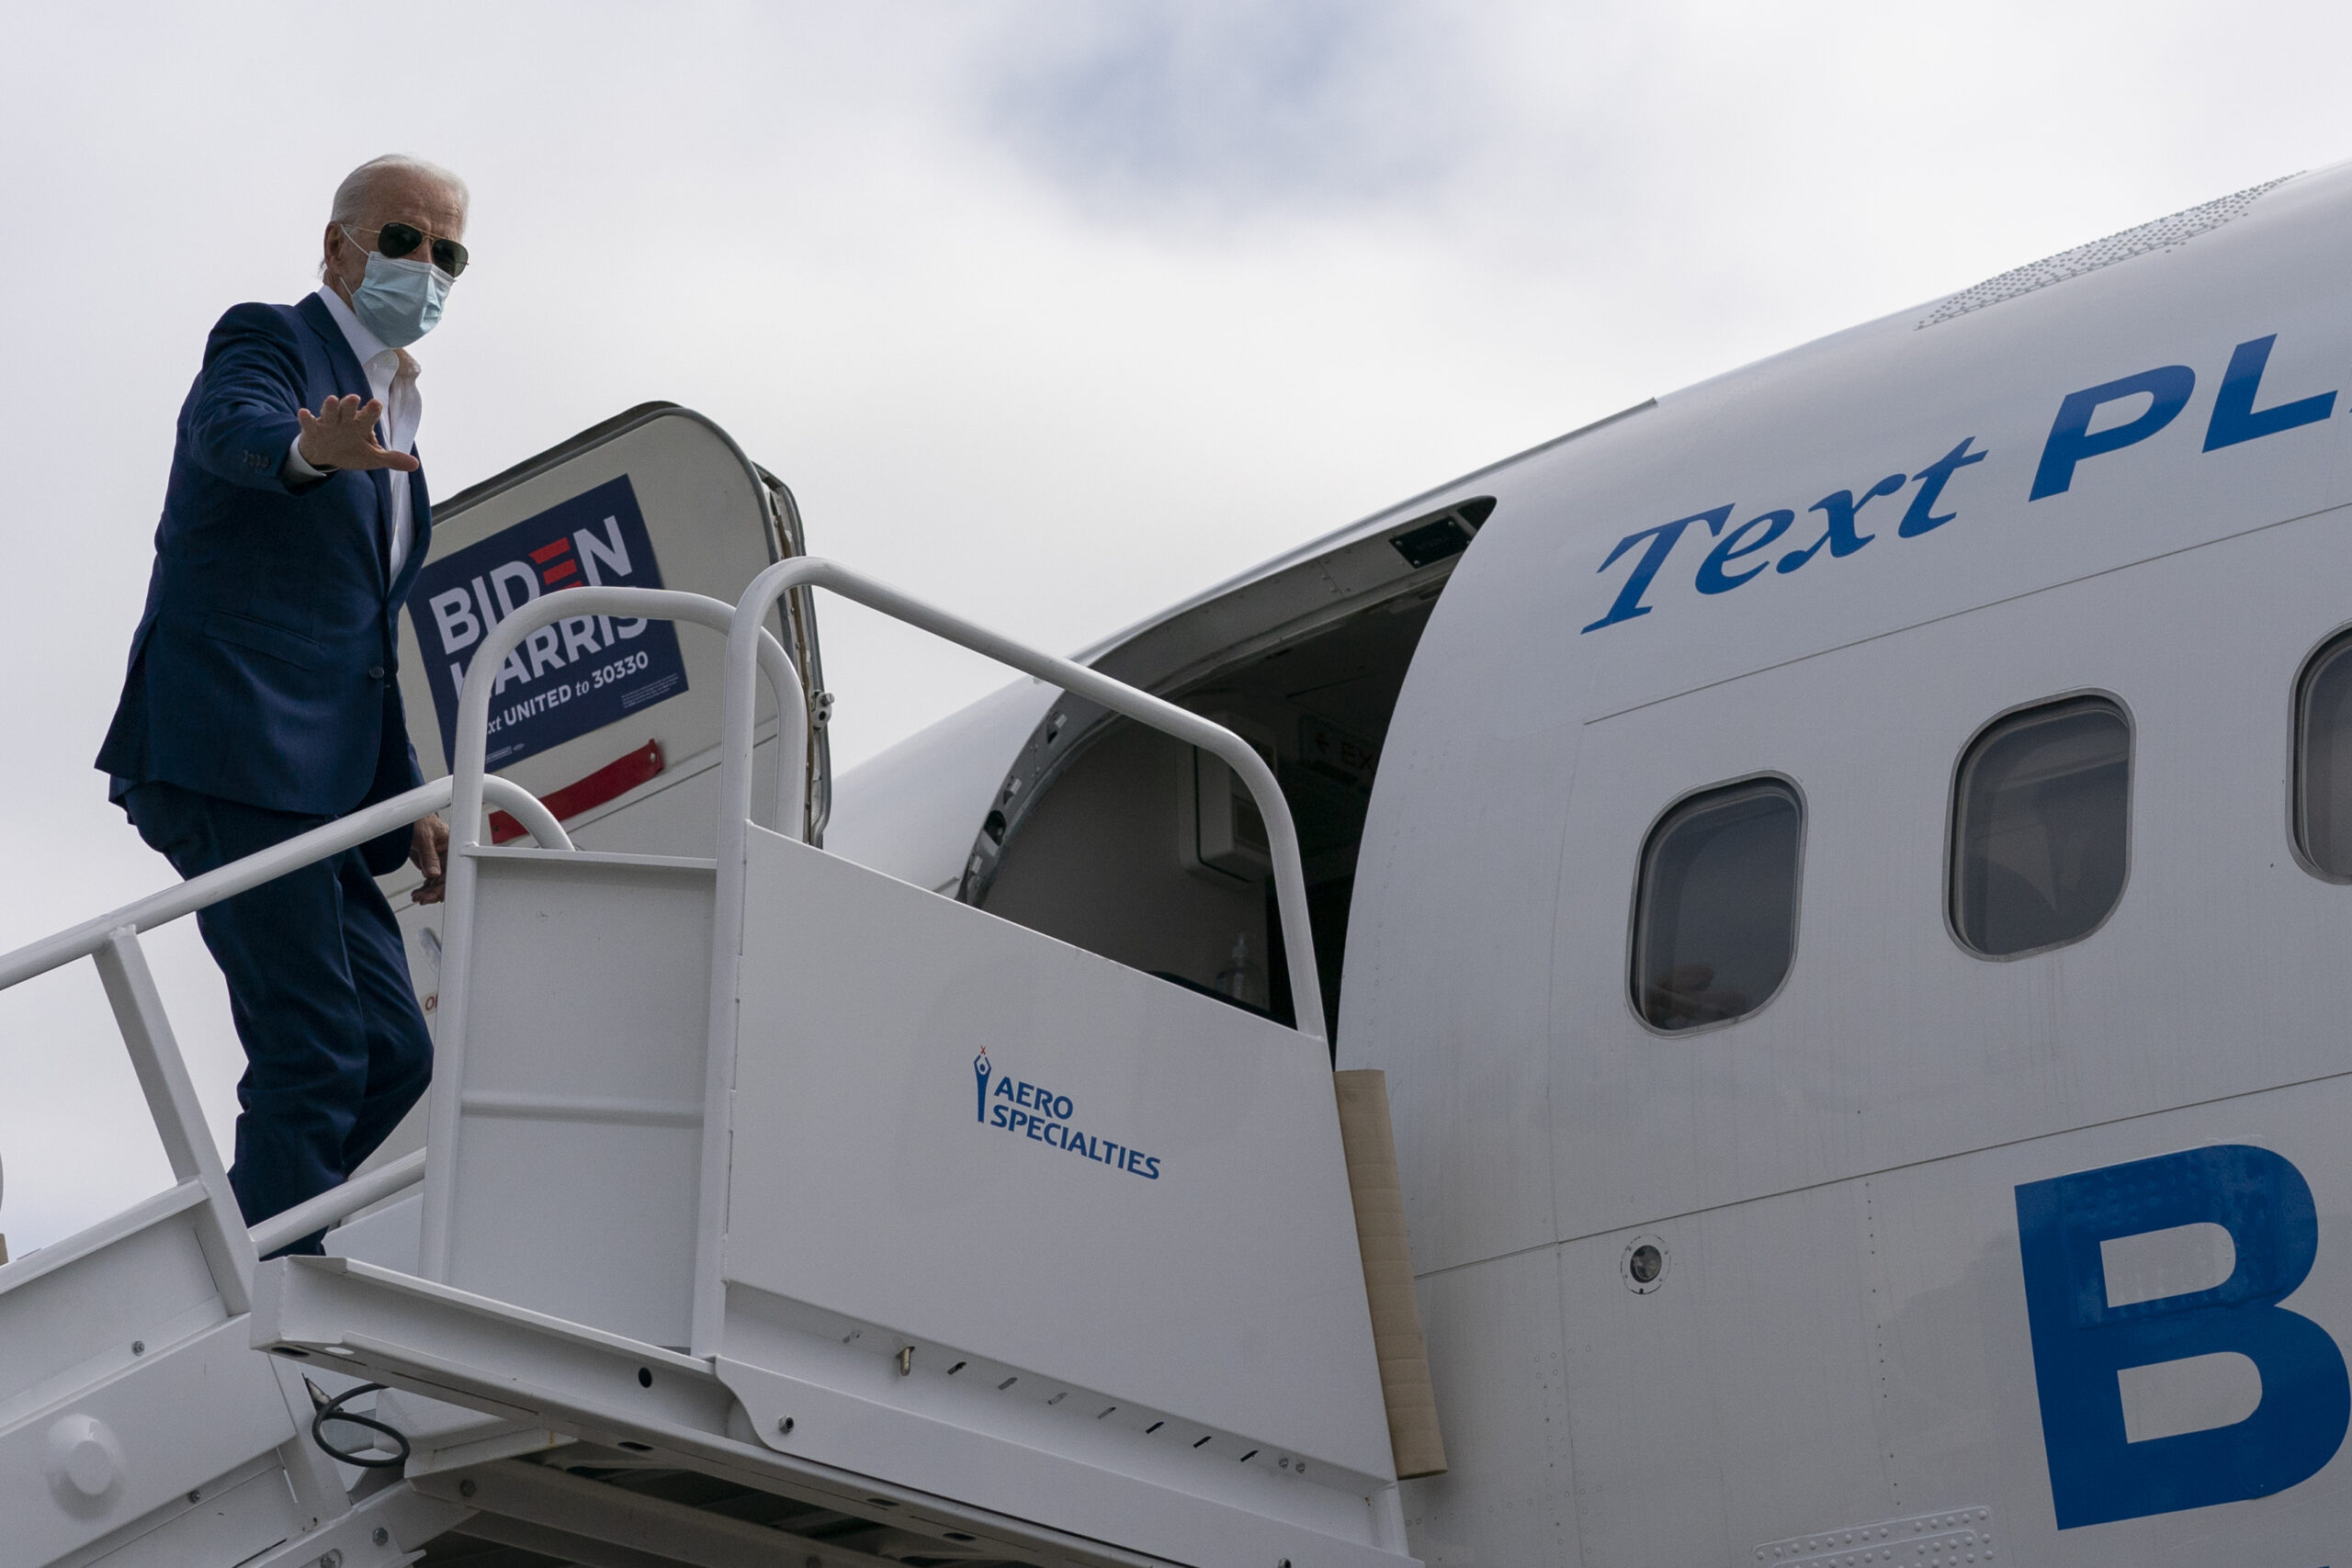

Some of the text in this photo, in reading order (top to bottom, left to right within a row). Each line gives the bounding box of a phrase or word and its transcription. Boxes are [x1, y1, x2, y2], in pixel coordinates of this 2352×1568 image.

[1580, 333, 2352, 635] Text PL
[429, 514, 632, 655] BIDEN
[487, 715, 503, 735] xt
[503, 683, 572, 727] UNITED
[574, 681, 591, 697] to
[591, 650, 650, 689] 30330
[989, 1104, 1161, 1179] SPECIALTIES
[993, 1076, 1073, 1120] AERO
[2014, 1144, 2351, 1531] B
